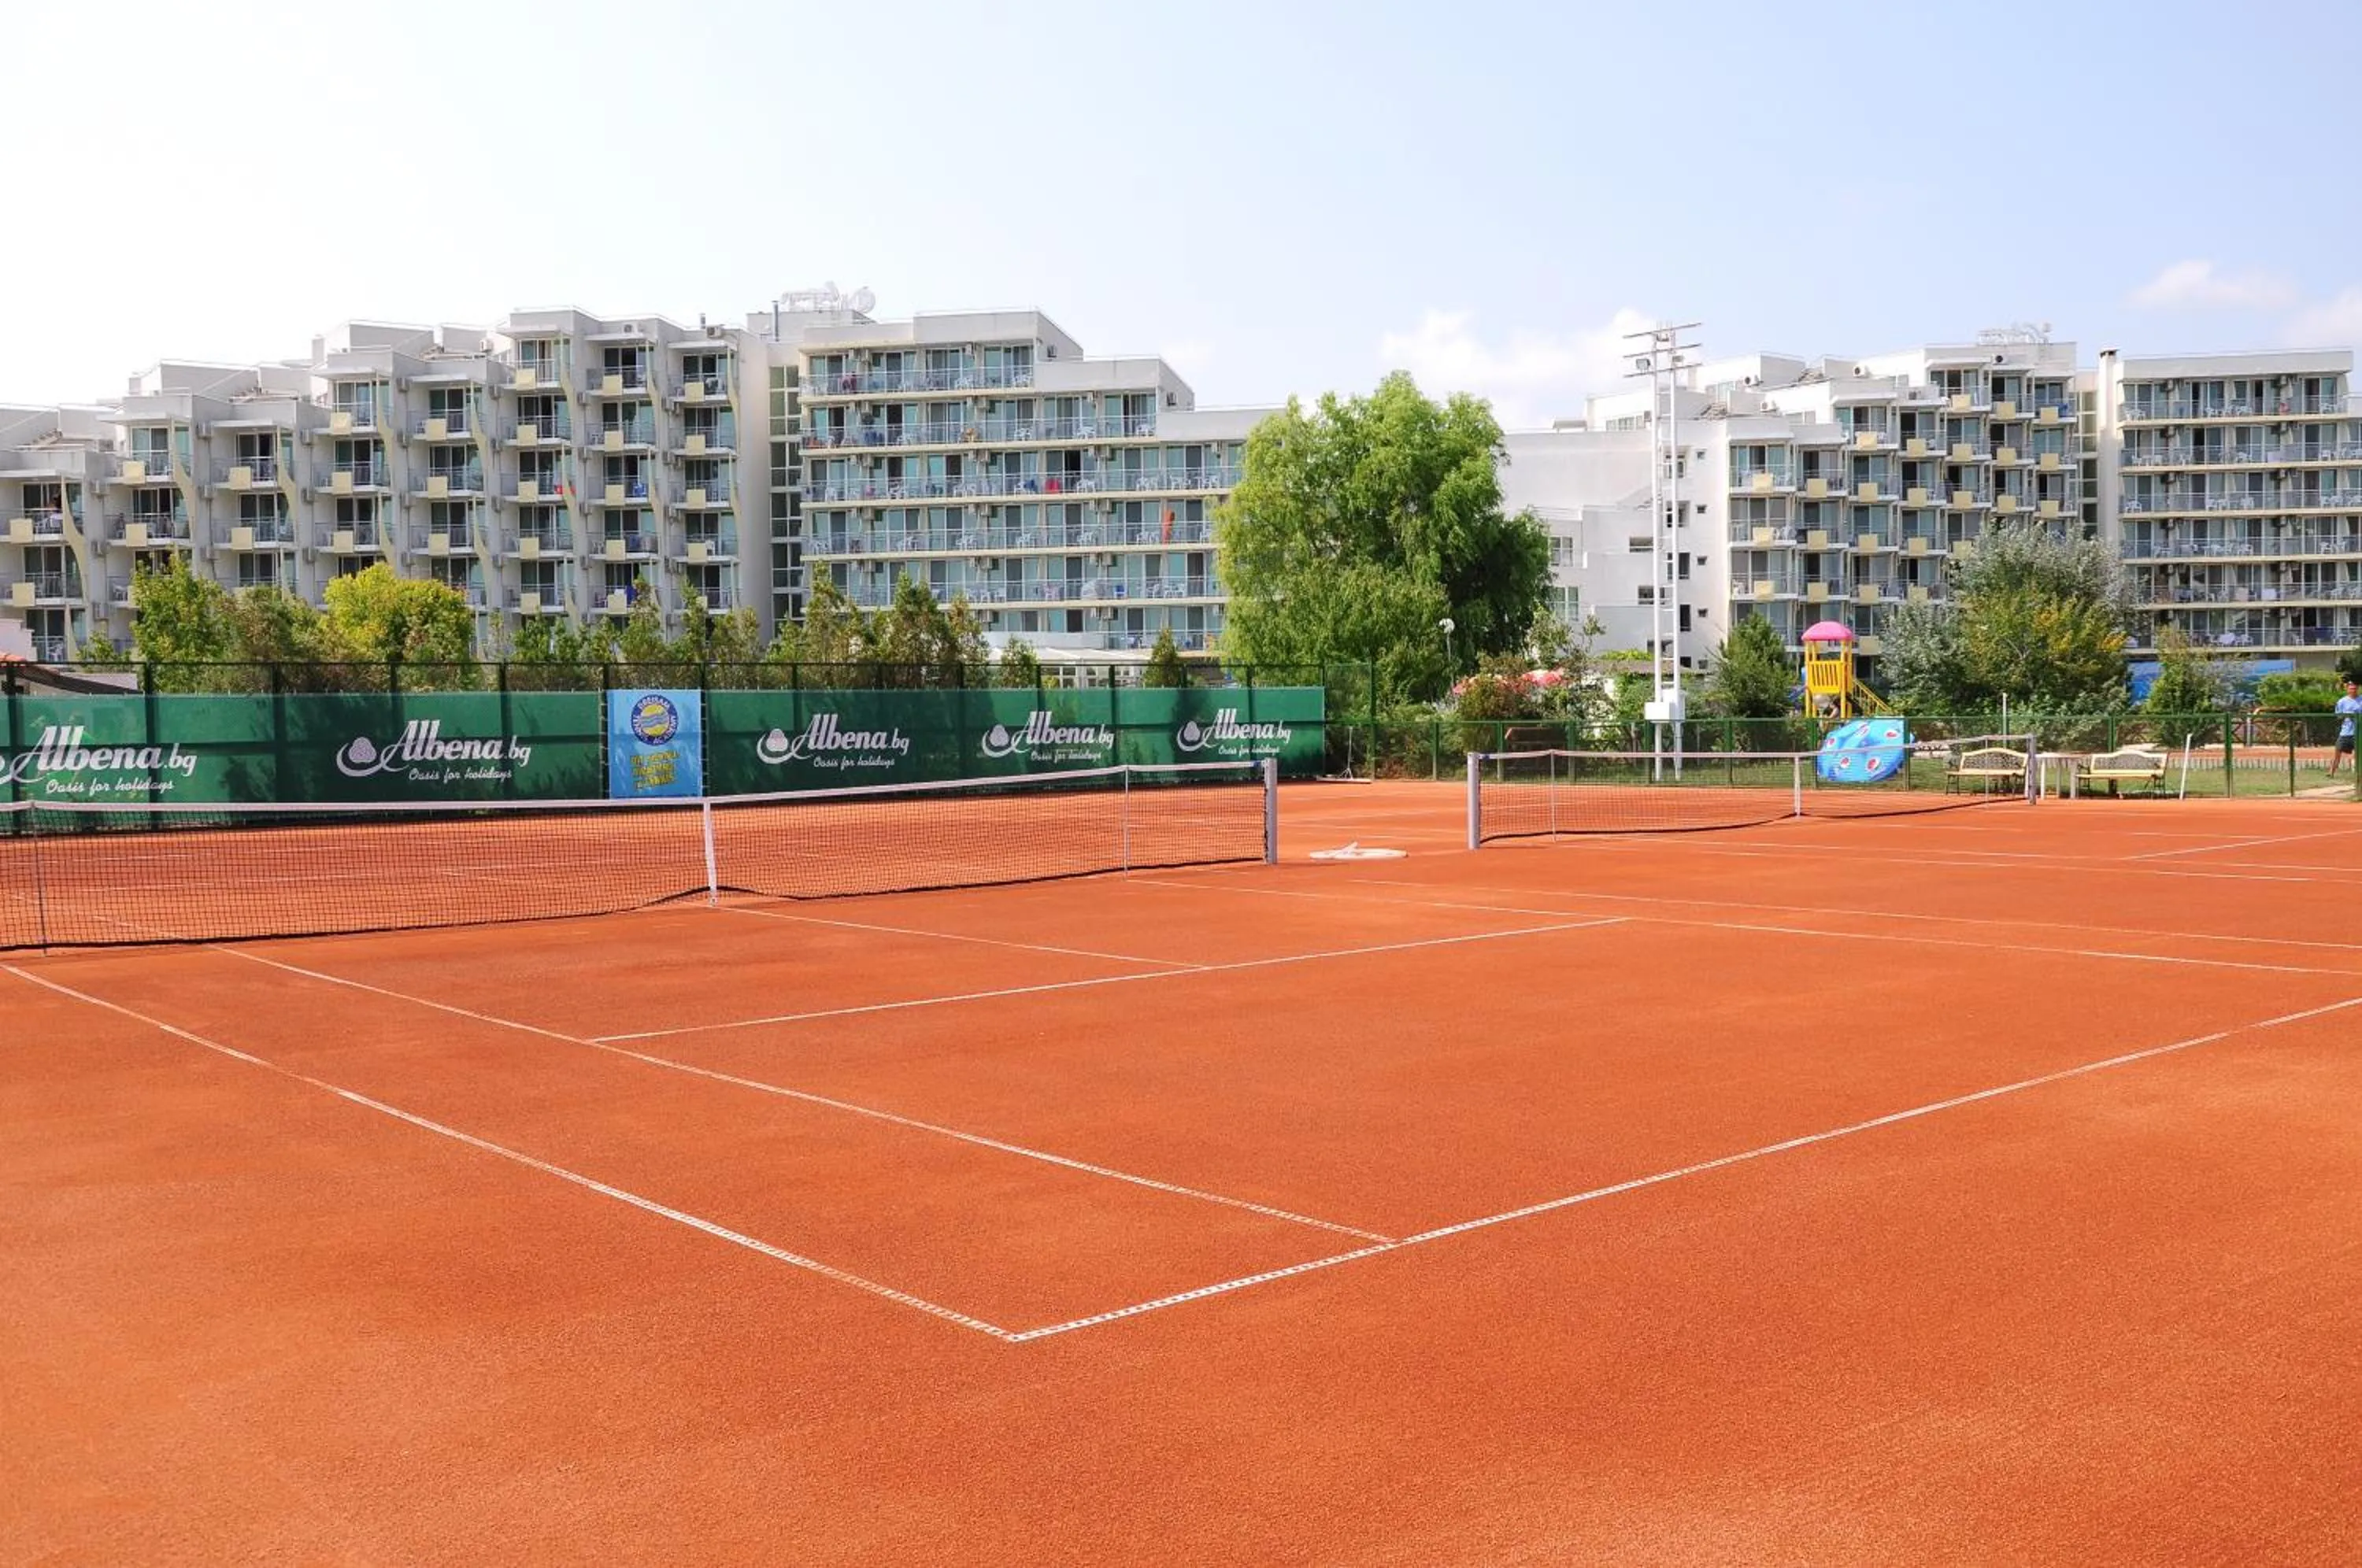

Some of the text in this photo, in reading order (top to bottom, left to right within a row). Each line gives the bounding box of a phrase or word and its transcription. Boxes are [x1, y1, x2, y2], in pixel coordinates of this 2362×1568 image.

[380, 719, 531, 772] Albena.bg
[791, 713, 910, 760] Albena.bg
[1011, 711, 1116, 753] Albena.bg
[1202, 708, 1292, 749] Albena.bg
[9, 725, 198, 783] Albena.bg
[409, 764, 513, 784] Oasis for holidays
[813, 755, 895, 771] Oasis for holidays
[1054, 749, 1065, 764] for
[46, 777, 175, 797] Oasis for holidays
